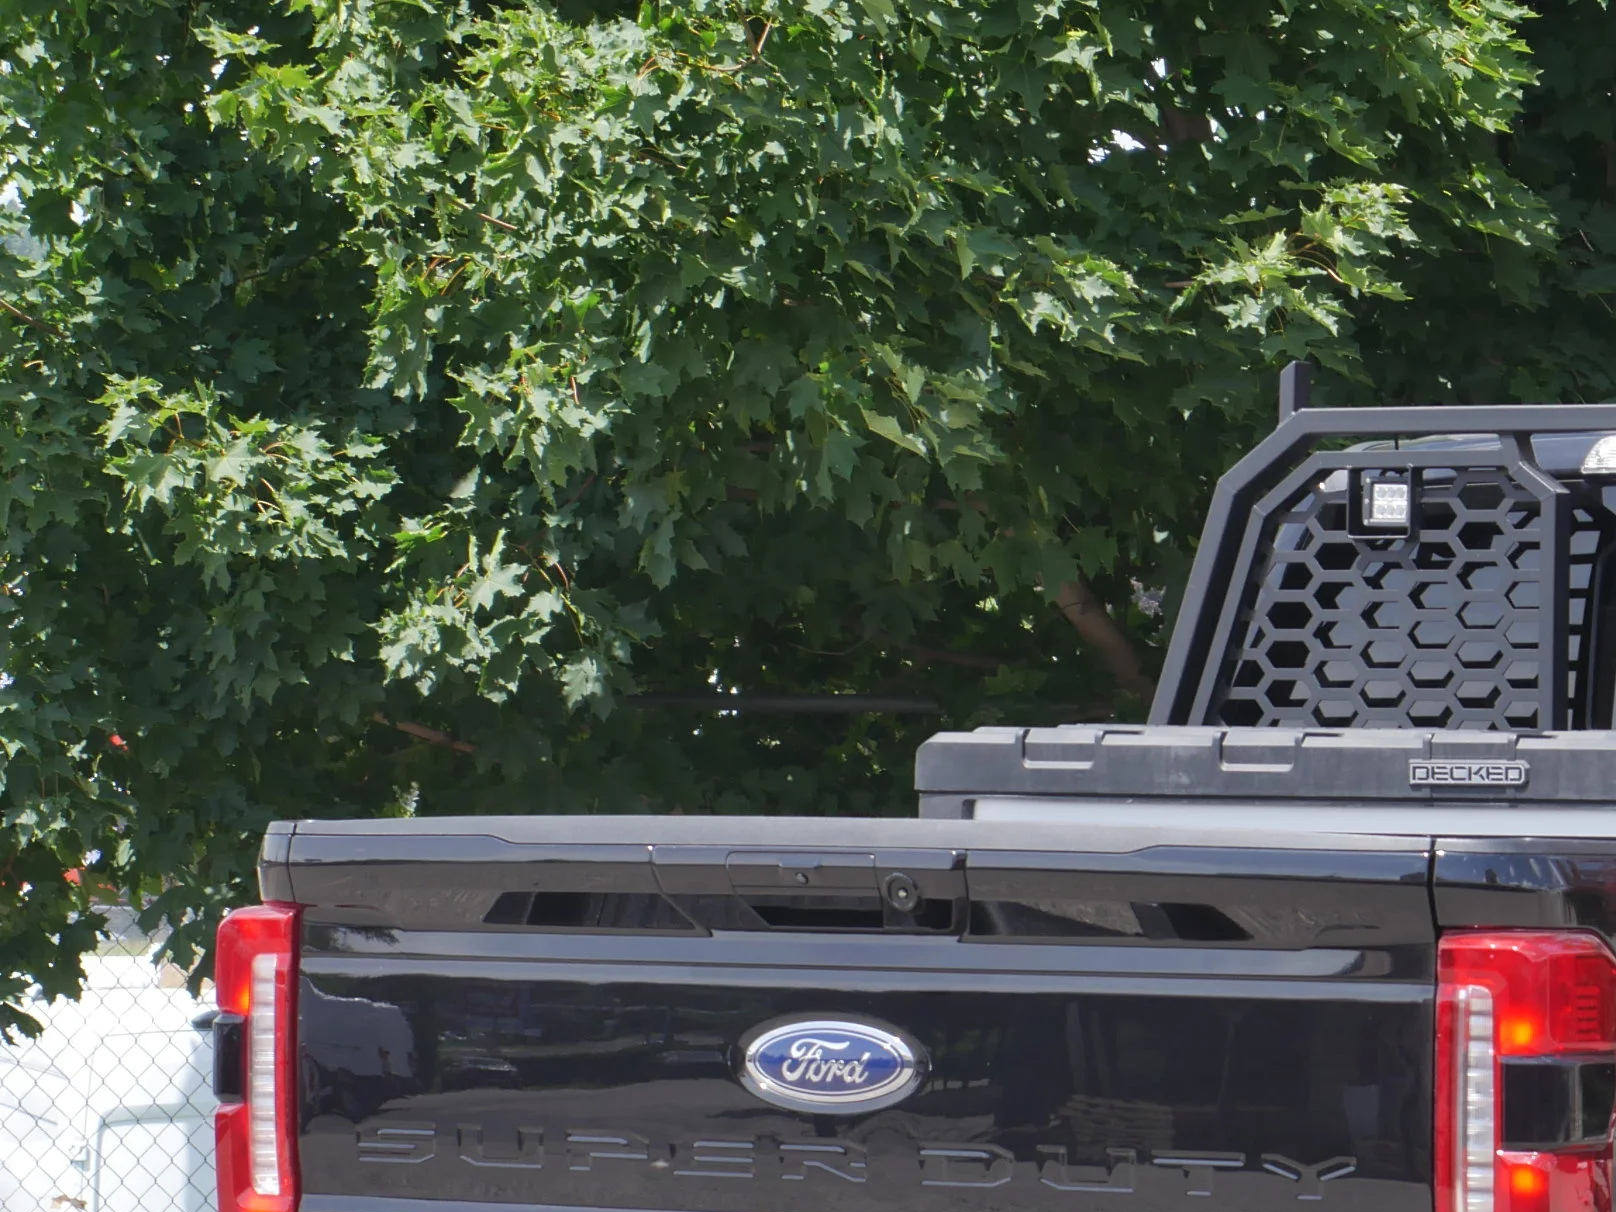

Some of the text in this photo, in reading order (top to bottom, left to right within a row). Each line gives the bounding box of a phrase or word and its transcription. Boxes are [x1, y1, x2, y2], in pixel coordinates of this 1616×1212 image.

[1412, 766, 1523, 781] DECKED
[782, 1038, 871, 1084] Ford
[356, 1122, 1358, 1200] SUPER DUTY
